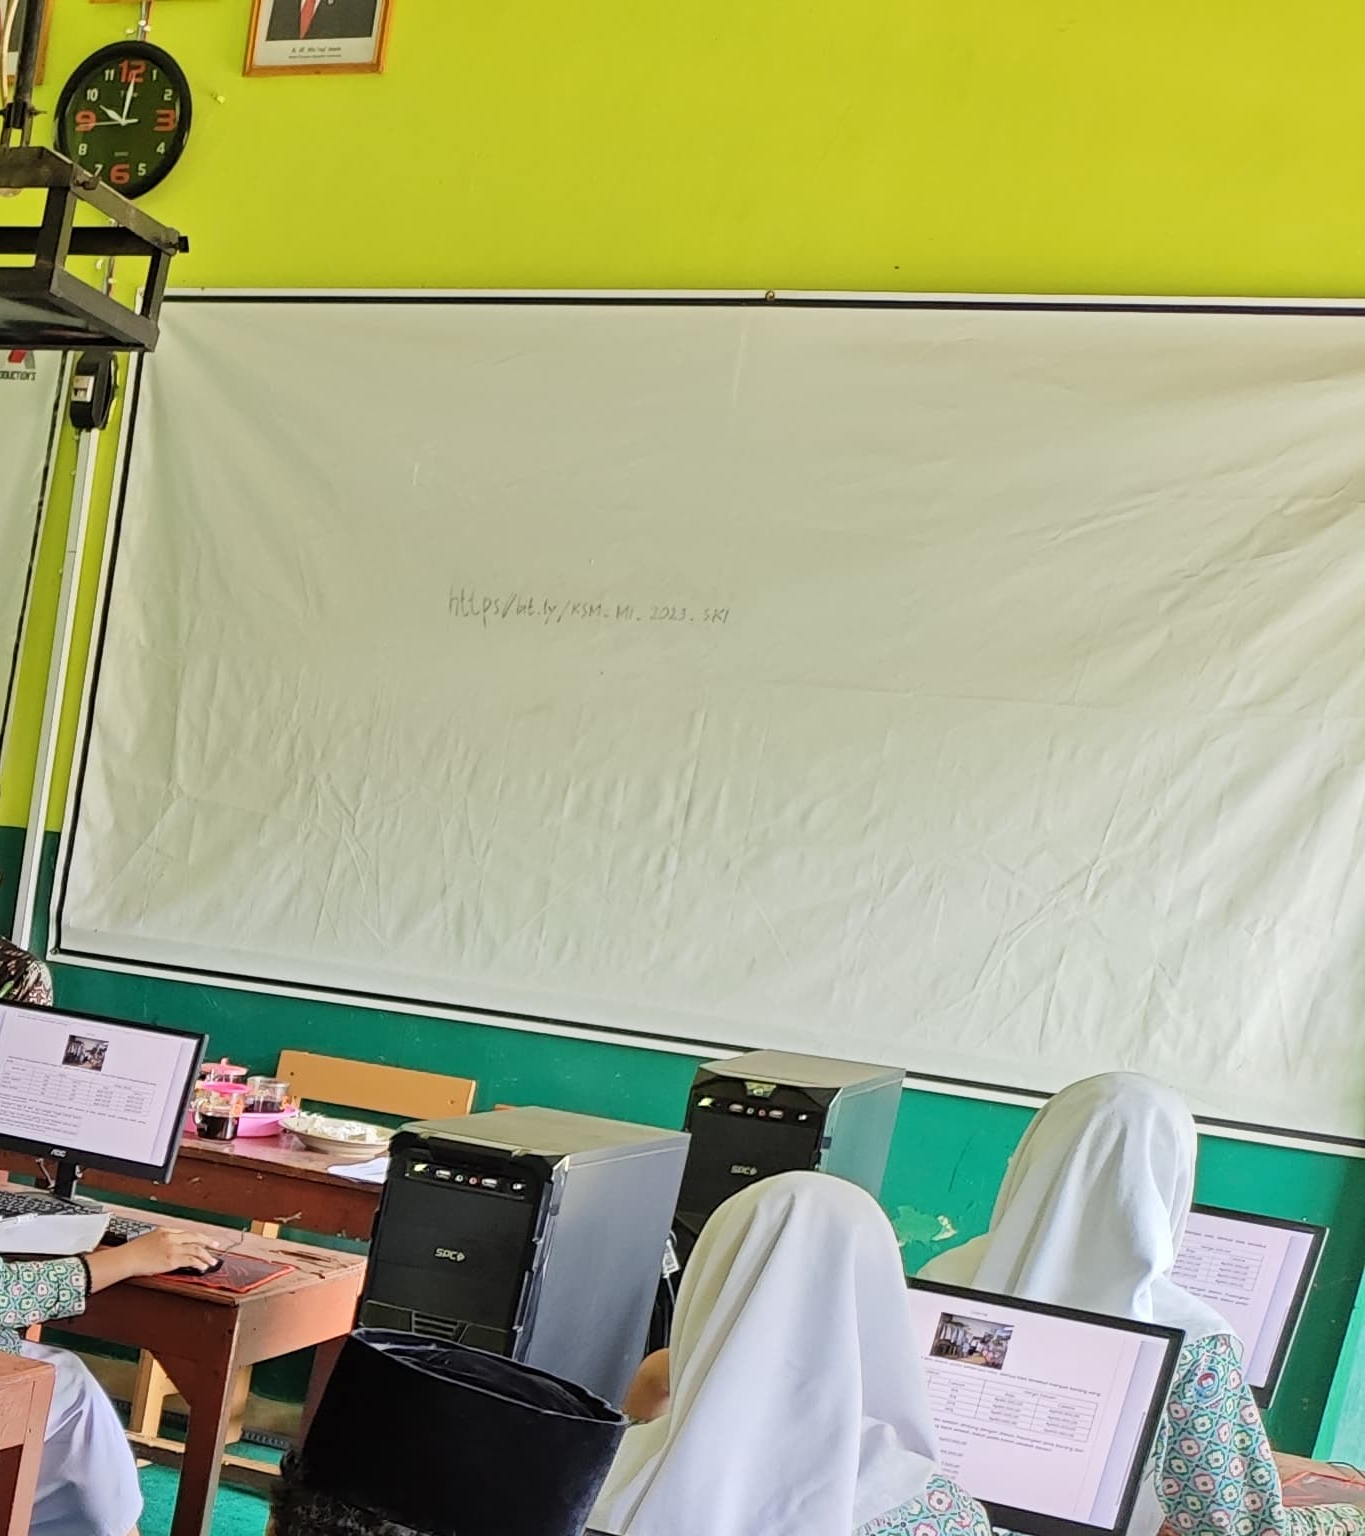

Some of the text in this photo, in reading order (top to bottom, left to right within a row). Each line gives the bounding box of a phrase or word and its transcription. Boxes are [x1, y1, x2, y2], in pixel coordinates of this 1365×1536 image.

[104, 69, 115, 81] 11
[120, 60, 146, 83] 12
[86, 88, 98, 101] 10
[163, 89, 173, 101] 2
[75, 110, 97, 132] 9
[154, 110, 177, 131] 3
[78, 143, 88, 156] 8
[156, 142, 166, 155] 4
[110, 164, 130, 184] 6
[137, 163, 147, 176] 5
